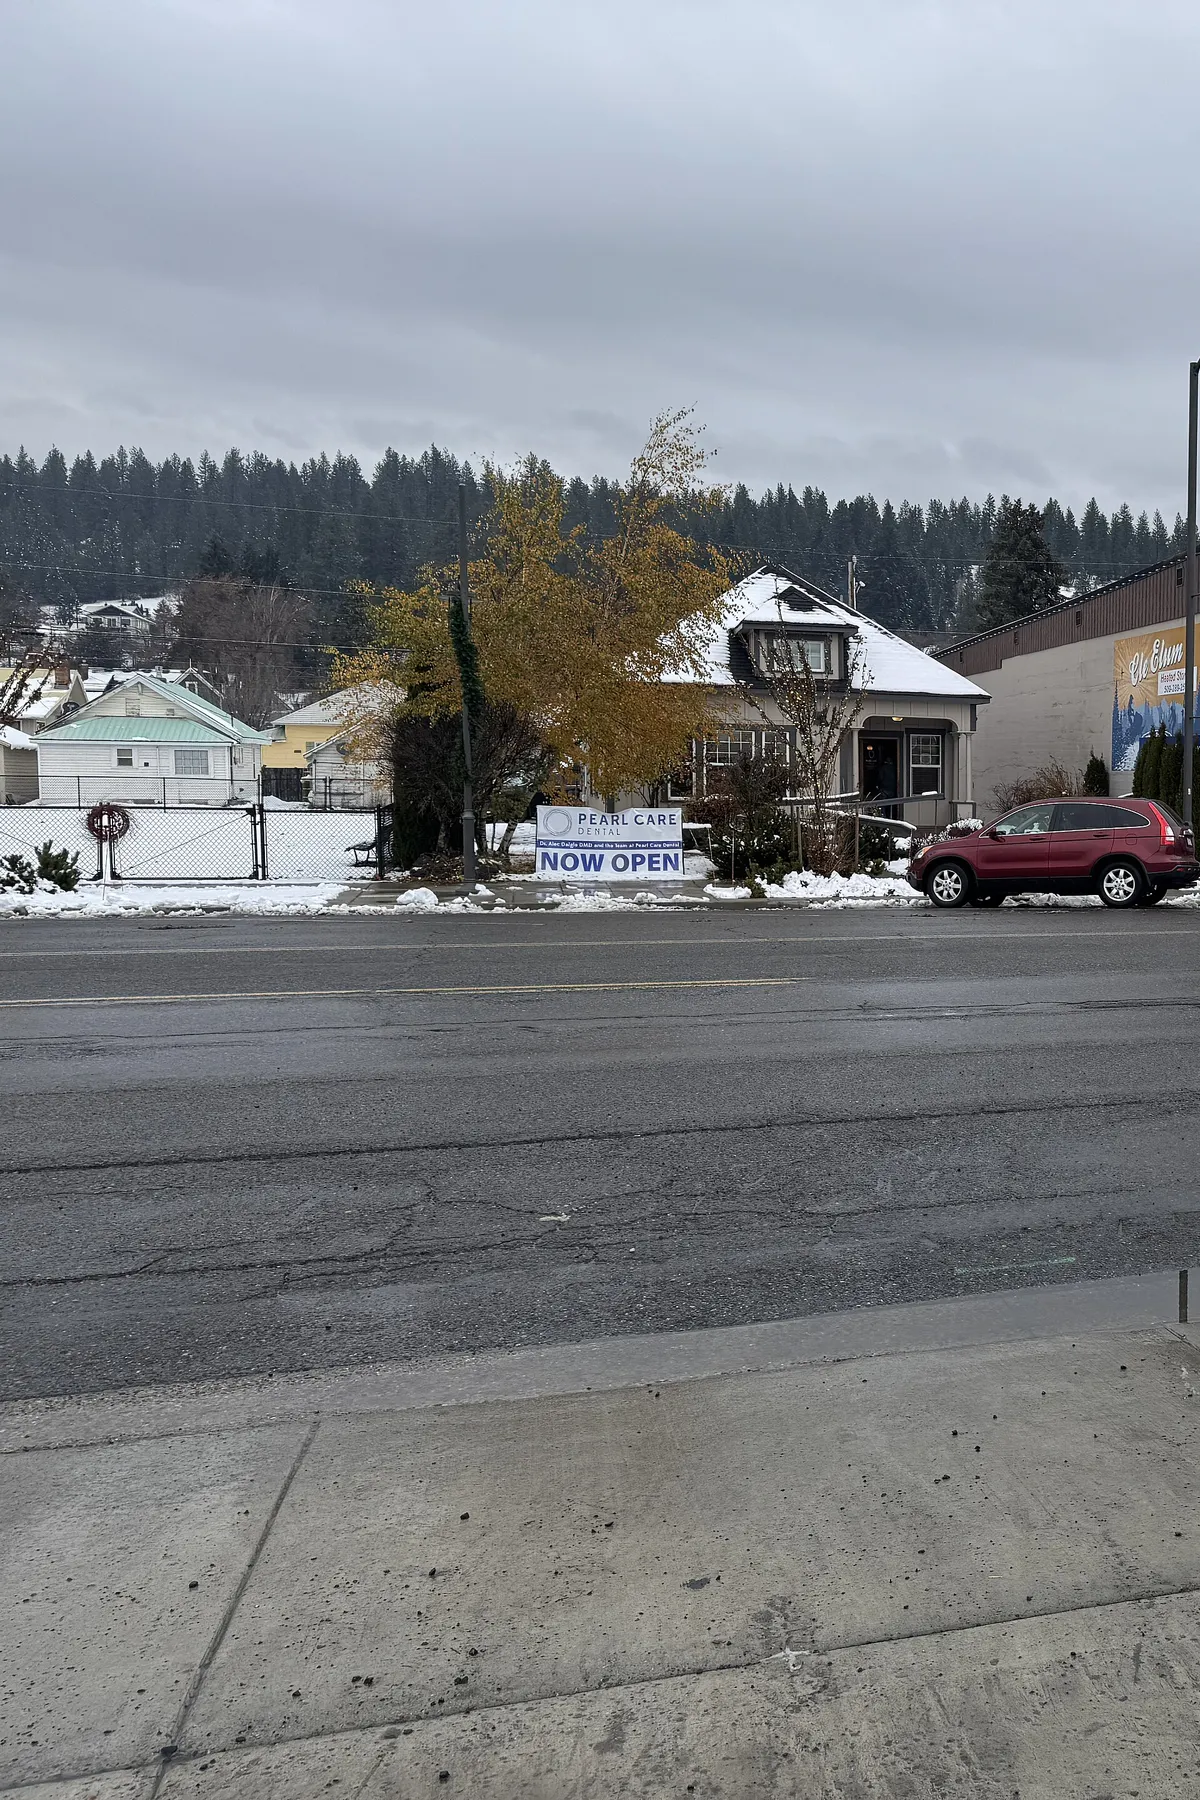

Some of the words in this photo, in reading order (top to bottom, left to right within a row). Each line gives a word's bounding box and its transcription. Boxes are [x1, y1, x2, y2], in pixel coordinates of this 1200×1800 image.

[1129, 652, 1148, 687] Cle
[1150, 639, 1183, 674] Elum
[578, 813, 628, 826] PEARL
[634, 814, 677, 825] CARE
[578, 827, 620, 836] DENTAL
[541, 852, 604, 872] NOW
[611, 853, 679, 872] OPEN
